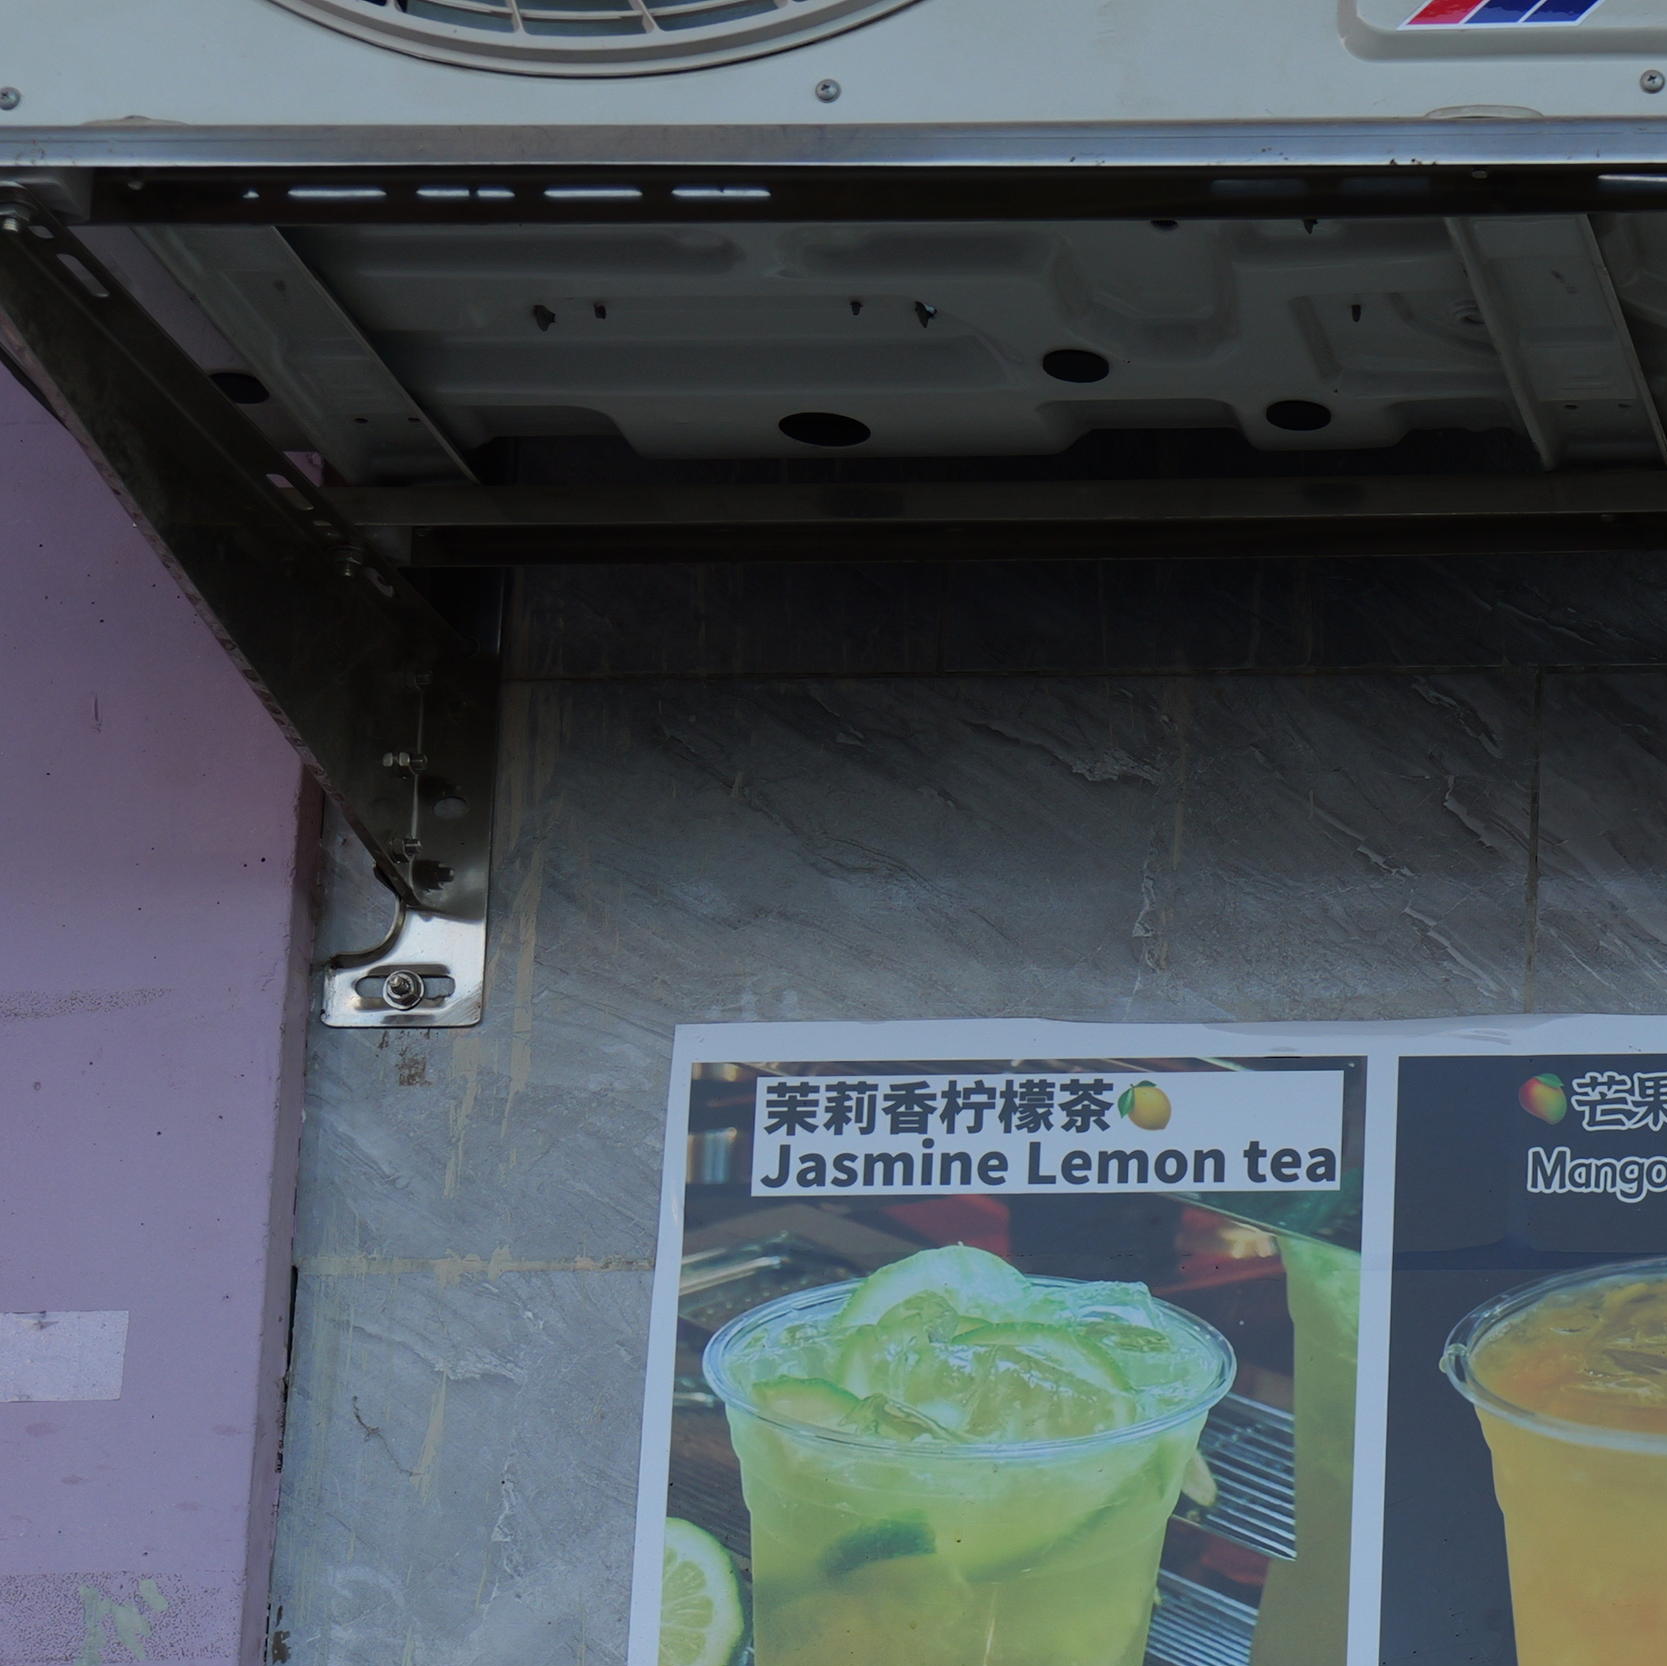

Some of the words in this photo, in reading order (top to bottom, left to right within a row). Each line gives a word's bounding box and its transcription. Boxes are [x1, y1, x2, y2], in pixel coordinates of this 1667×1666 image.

[764, 1079, 1115, 1136] 茉莉香柠檬茶
[760, 1139, 1009, 1188] Jasmine
[1027, 1142, 1227, 1186] Lemon
[1242, 1141, 1338, 1183] tea
